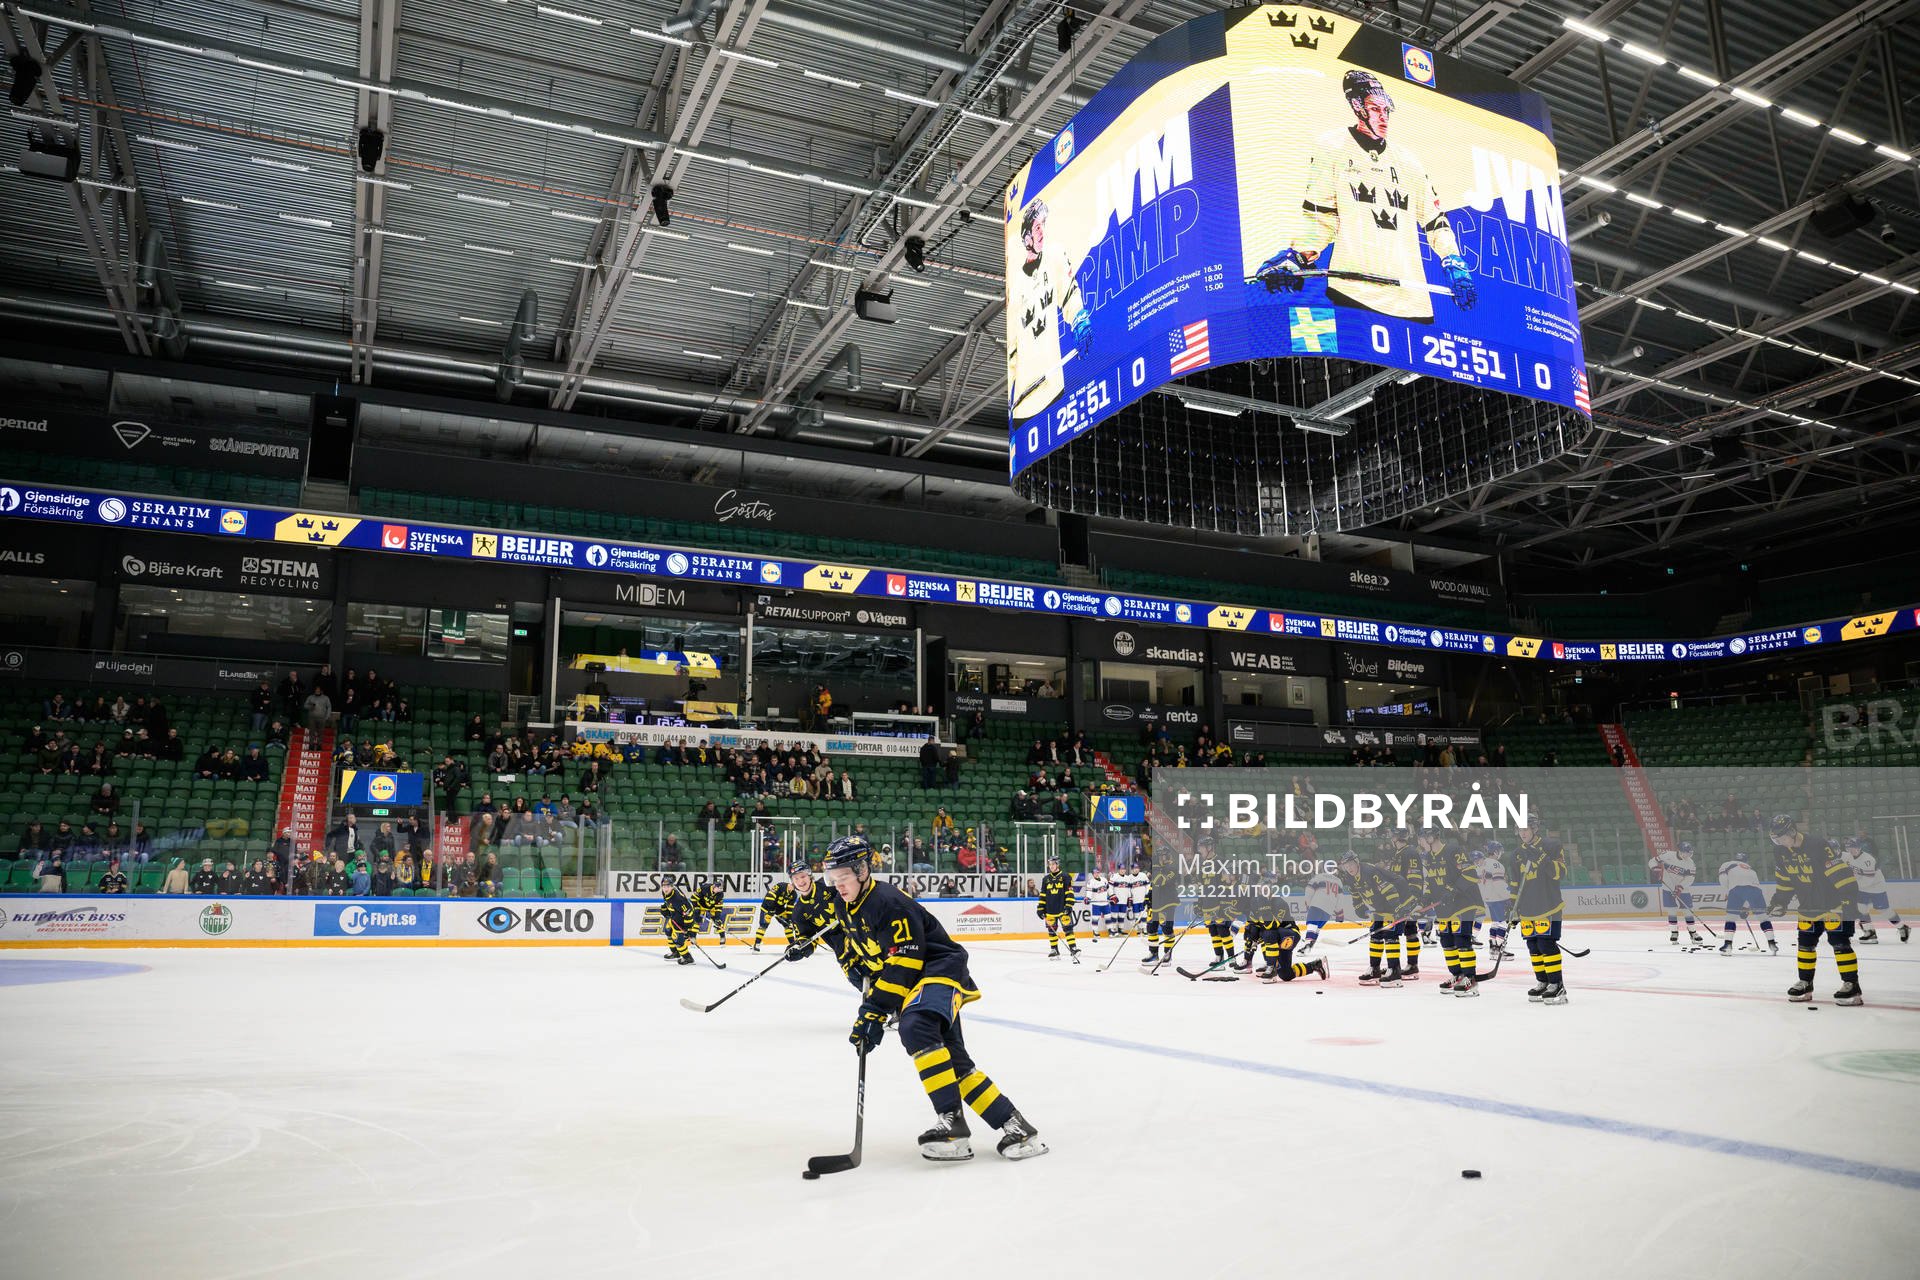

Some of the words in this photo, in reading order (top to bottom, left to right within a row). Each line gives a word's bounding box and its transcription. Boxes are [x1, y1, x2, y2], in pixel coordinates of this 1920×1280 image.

[1088, 112, 1193, 248] JVM
[1464, 144, 1568, 248] JVM
[1076, 187, 1200, 316] CAMP
[1452, 207, 1575, 303] CAMP
[1203, 263, 1222, 274] 16.30
[1204, 273, 1223, 283] 18.00
[1204, 282, 1224, 292] 15.00
[1371, 324, 1389, 354] 0
[1442, 332, 1451, 340] TO
[1454, 335, 1483, 347] FACE-OFF
[1422, 335, 1506, 380] 25:51
[1131, 357, 1146, 388] 0
[1452, 370, 1475, 381] PERIOD
[1535, 362, 1552, 390] 0
[1056, 379, 1111, 436] 25:51
[1027, 426, 1039, 453] 0
[208, 438, 300, 460] SKÅNEPORTAR
[25, 491, 90, 507] Gjensidige
[714, 489, 777, 522] Göstas
[24, 503, 84, 520] Försäkring
[132, 502, 211, 519] SERAFIM
[131, 515, 194, 529] FINANS
[410, 532, 464, 546] SVENSKA
[409, 541, 438, 553] SPEL
[502, 535, 574, 558] BEIJER
[501, 552, 574, 565] BYGGMATERIAL
[610, 548, 661, 562] Gjensidige
[148, 562, 185, 577] Bjäre
[186, 564, 224, 579] Kraft
[260, 559, 319, 578] STENA
[610, 558, 657, 573] Försäkring
[692, 556, 753, 571] SERAFIM
[692, 568, 741, 579] FINANS
[1349, 570, 1378, 585] akea
[240, 575, 319, 590] RECYCLING
[908, 580, 950, 592] SVENSKA
[1430, 579, 1457, 593] WOOD
[1457, 583, 1469, 594] ON
[1470, 585, 1491, 597] WALL
[616, 584, 685, 606] MIDEM
[908, 588, 931, 598] SPEL
[979, 583, 1035, 602] BEIJER
[1062, 592, 1101, 605] Gjensidige
[979, 597, 1035, 609] BYGGMATERIAL
[1062, 602, 1098, 615] Försäkring
[1124, 599, 1170, 612] SERAFIM
[869, 611, 907, 626] Vågen
[1124, 609, 1162, 620] FINANS
[1285, 618, 1317, 628] SVENSKA
[1285, 626, 1303, 634] SPEL
[1337, 620, 1379, 636] BEIJER
[1337, 632, 1380, 642] BYGGMATERIAL
[1398, 628, 1427, 638] Gjensidige
[1444, 632, 1479, 643] SERAFIM
[1748, 630, 1797, 644] SERAFIM
[1399, 636, 1426, 646] Försäkring
[1445, 641, 1473, 650] FINANS
[1688, 641, 1725, 650] Gjensidige
[1750, 641, 1789, 651] FINANS
[1618, 644, 1665, 655] BEIJER
[1689, 649, 1723, 658] Försäkring
[106, 661, 153, 672] Liljedahl
[1230, 652, 1282, 671] WEAB
[1350, 658, 1378, 674] Valvet
[1387, 659, 1425, 673] Bildeve
[1166, 706, 1198, 723] renta
[585, 728, 648, 742] SKÅNEPORTAR
[653, 733, 665, 742] 010
[667, 734, 678, 743] 444
[688, 735, 697, 743] 00
[1395, 734, 1415, 743] melin
[826, 740, 883, 753] SKÅNEPORTAR
[886, 744, 897, 752] 010
[899, 745, 910, 753] 444
[1455, 852, 1468, 864] 24
[1577, 894, 1626, 907] Backahill
[12, 913, 85, 922] KLIPPANS
[88, 913, 126, 922] BUSS
[203, 916, 228, 933] RÖGLE
[370, 912, 417, 927] Flytt.se
[890, 917, 913, 944] 21
